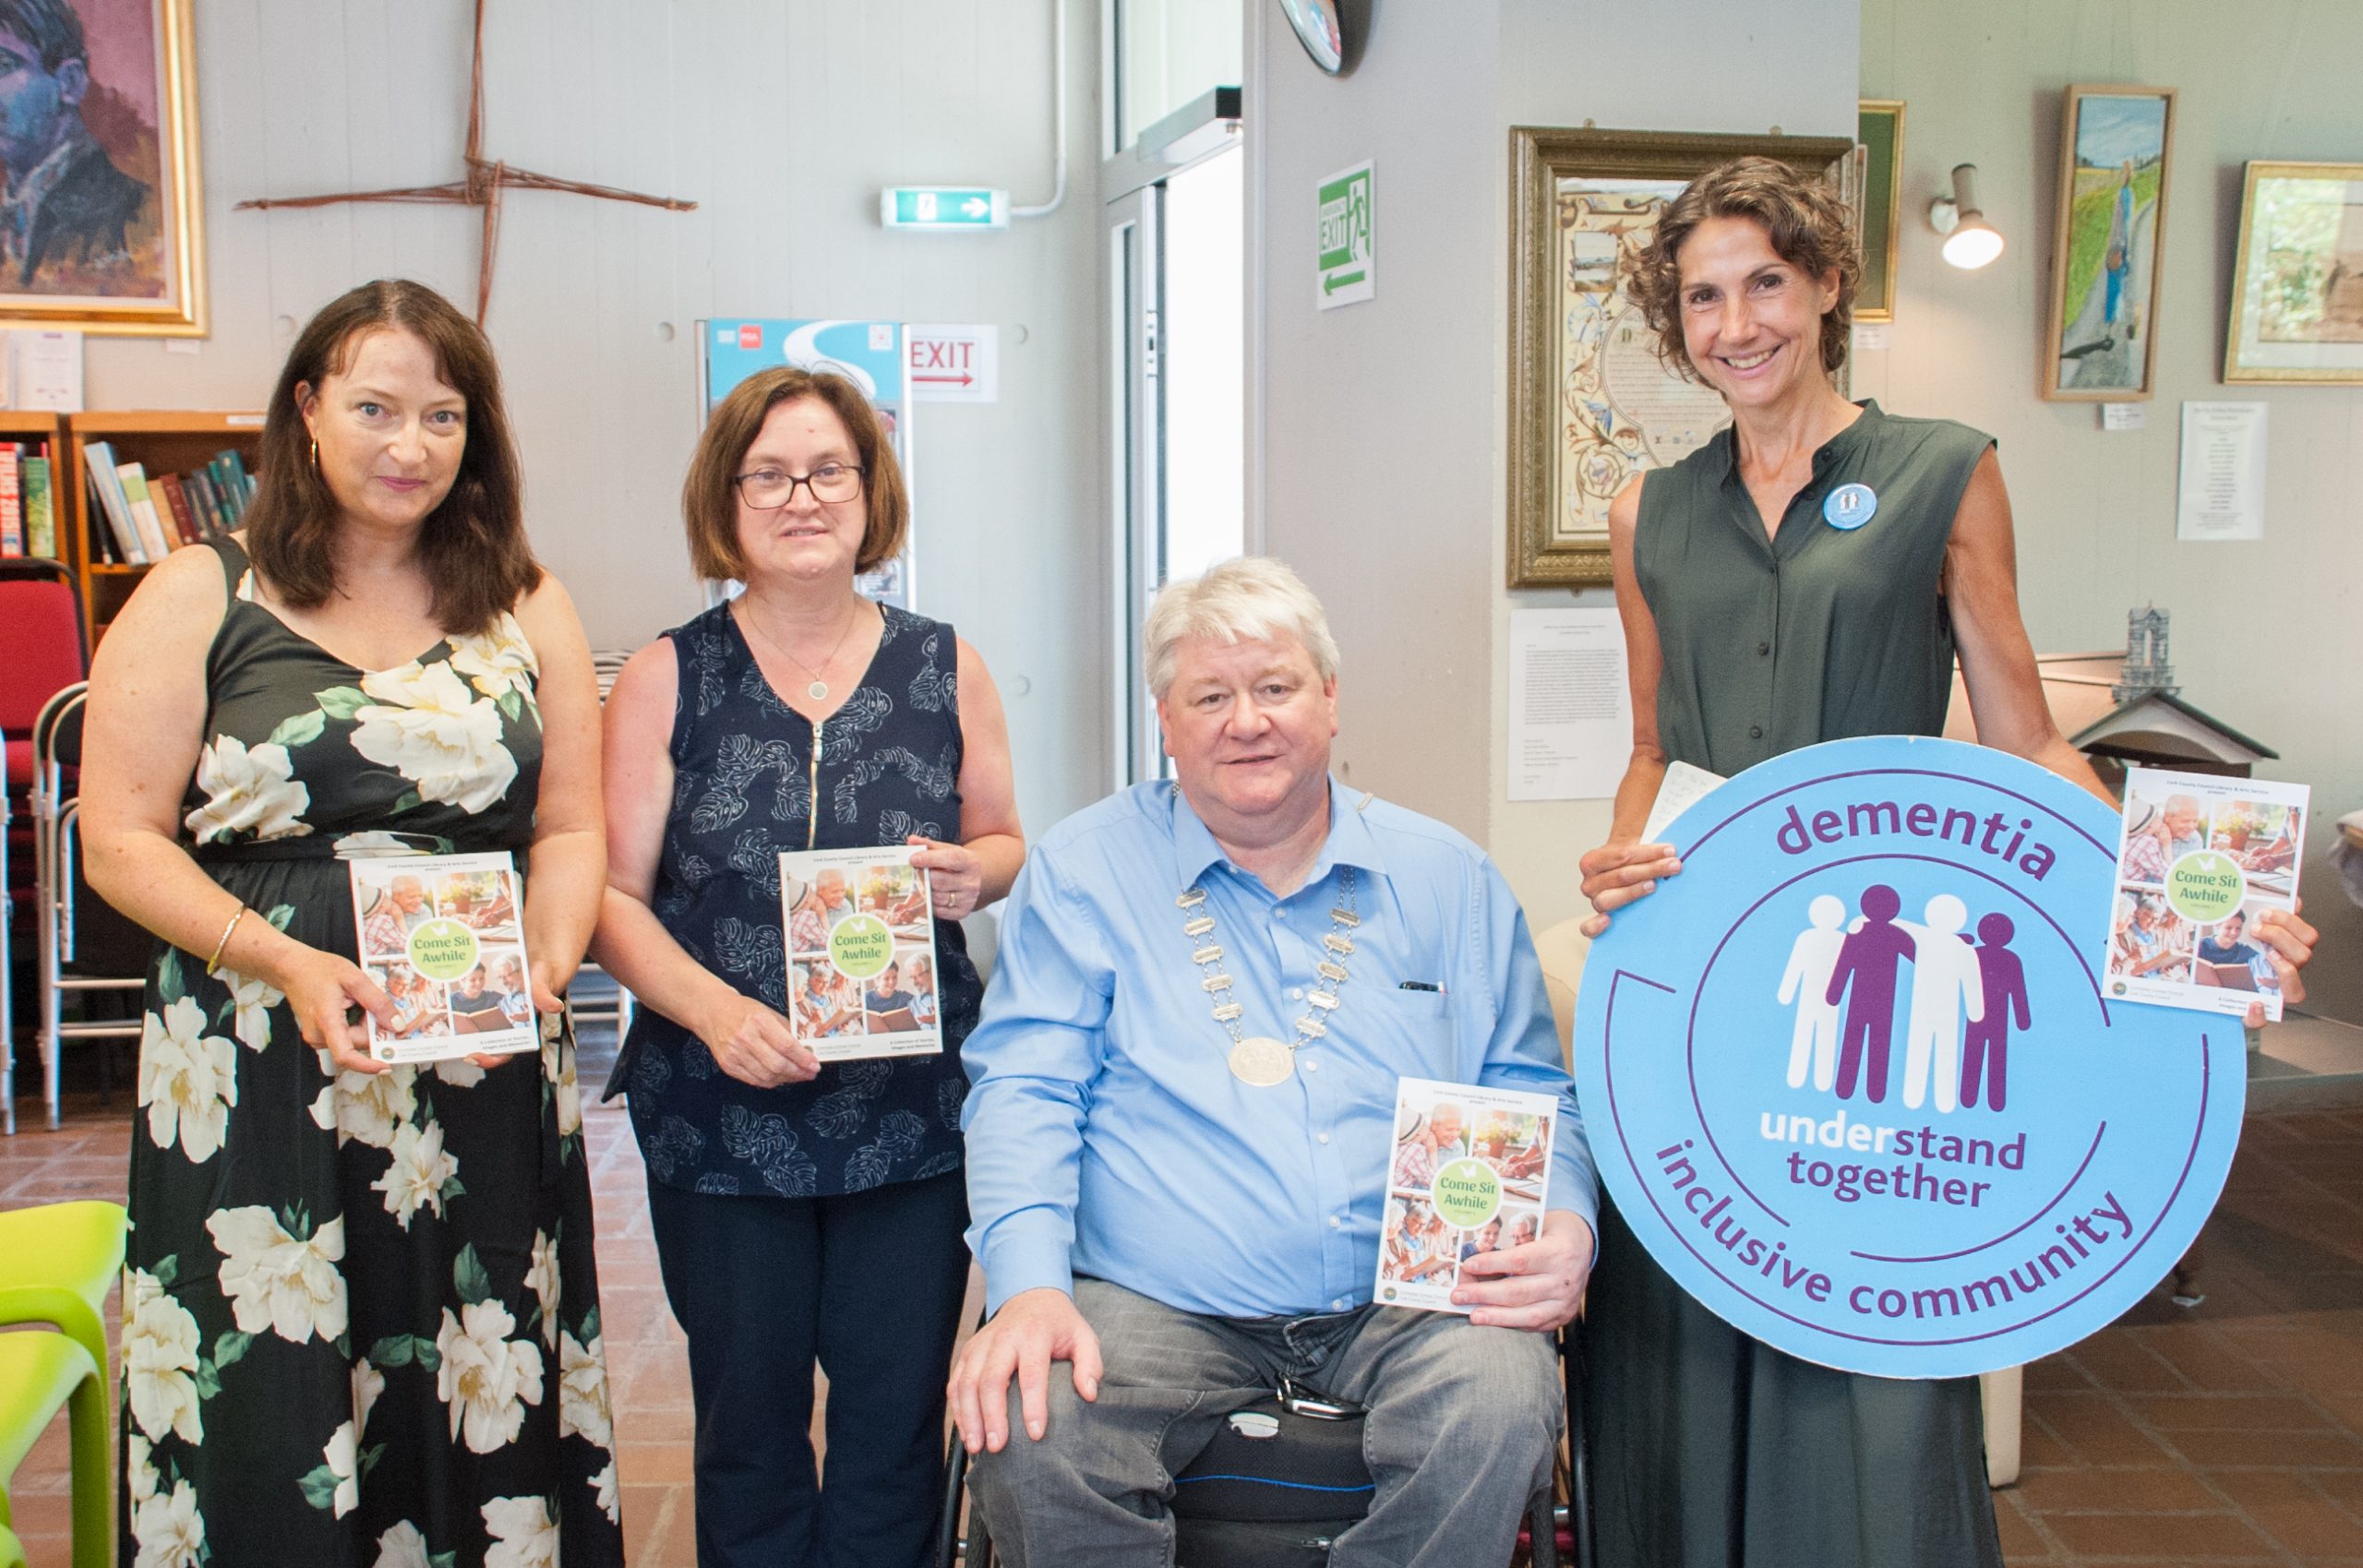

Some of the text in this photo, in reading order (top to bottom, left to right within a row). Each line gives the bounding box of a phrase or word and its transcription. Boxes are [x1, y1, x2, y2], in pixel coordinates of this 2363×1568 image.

[1322, 213, 1346, 250] EXIT
[910, 341, 975, 368] EXIT
[1776, 800, 2057, 881] dementia
[2175, 870, 2237, 888] Come Sit
[2179, 887, 2228, 904] Awhile
[414, 935, 470, 950] Come Sit
[835, 931, 886, 946] Come Sit
[422, 950, 466, 963] Awhile
[842, 947, 882, 960] Awhile
[1760, 1109, 2026, 1170] understand
[1440, 1177, 1495, 1194] Come Sit
[1787, 1151, 1991, 1207] together
[1444, 1193, 1487, 1209] Awhile
[1656, 1139, 2134, 1320] inclusive community
